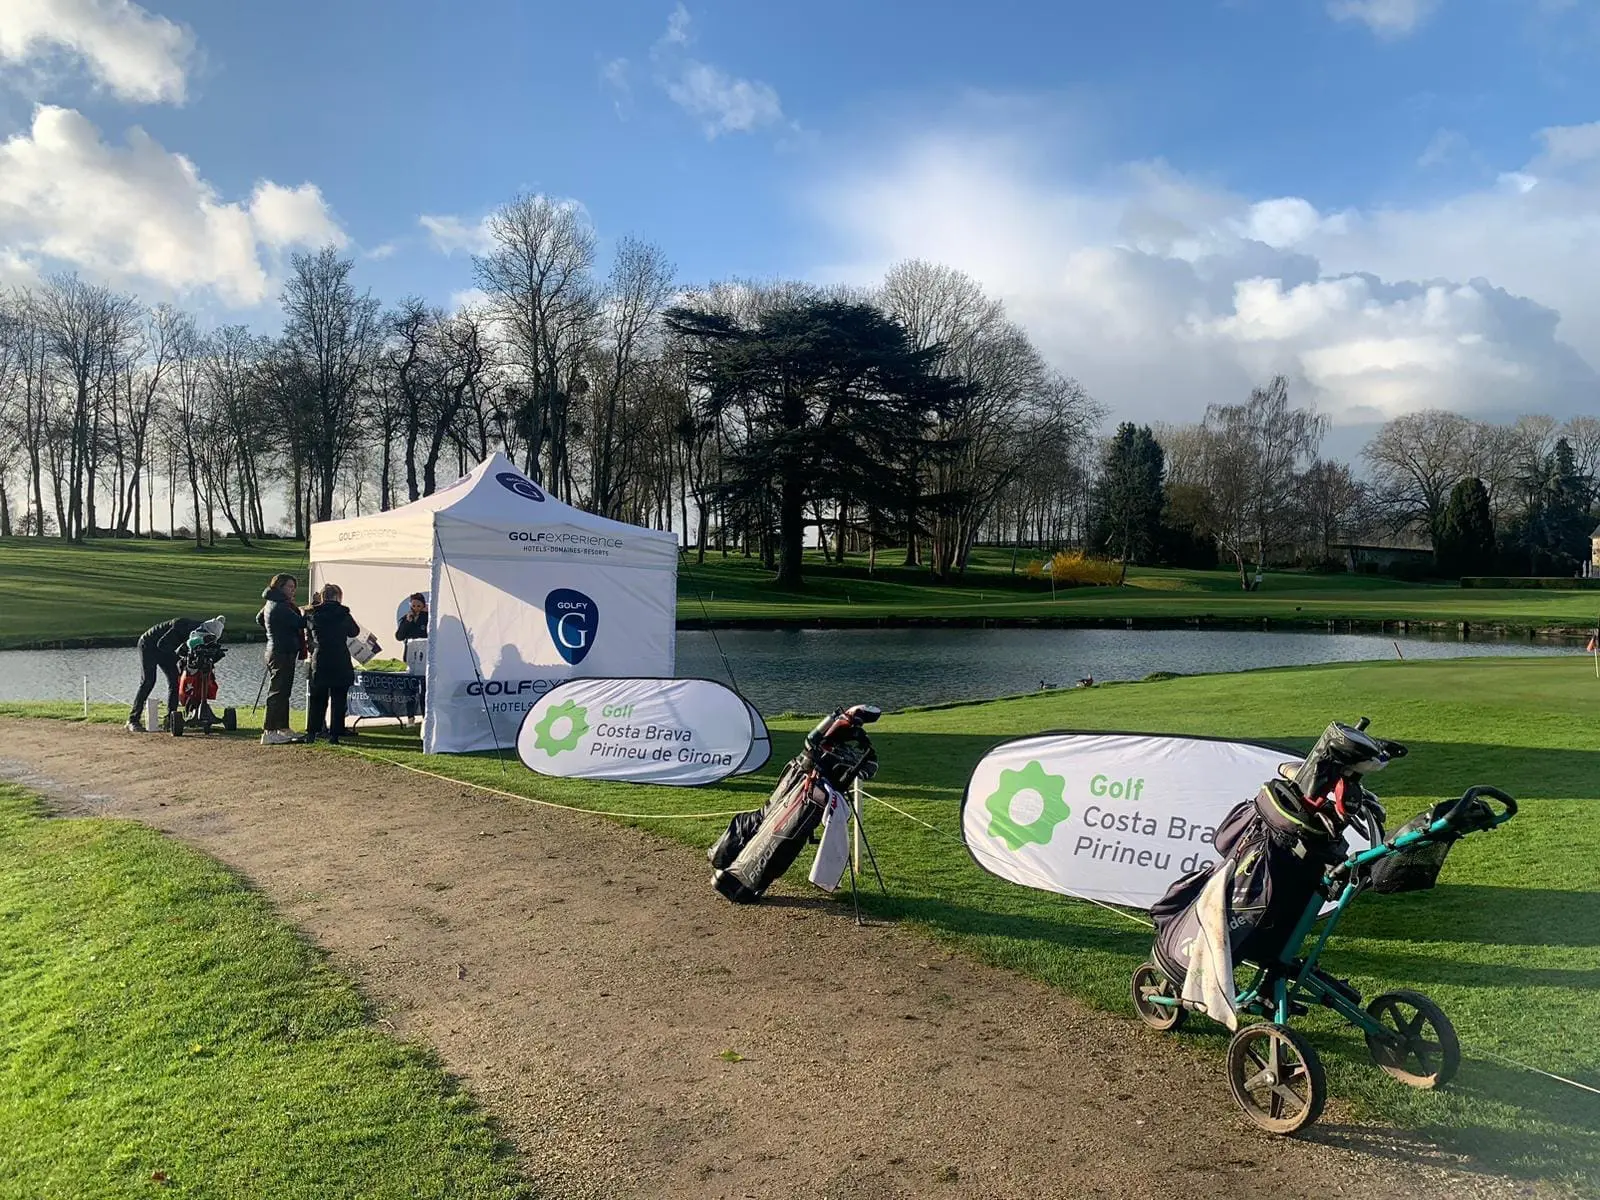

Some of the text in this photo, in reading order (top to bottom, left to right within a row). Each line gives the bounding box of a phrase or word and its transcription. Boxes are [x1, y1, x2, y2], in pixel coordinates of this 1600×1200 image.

[557, 601, 588, 610] GOLFY
[558, 612, 588, 649] G
[602, 703, 635, 719] Golf
[596, 723, 692, 742] Costa Brava
[590, 742, 733, 766] Pirineu de Girona
[1089, 773, 1145, 801] Golf
[1083, 805, 1216, 845] Costa Bra
[748, 840, 779, 882] PROOF
[1073, 835, 1215, 874] Pirineu de
